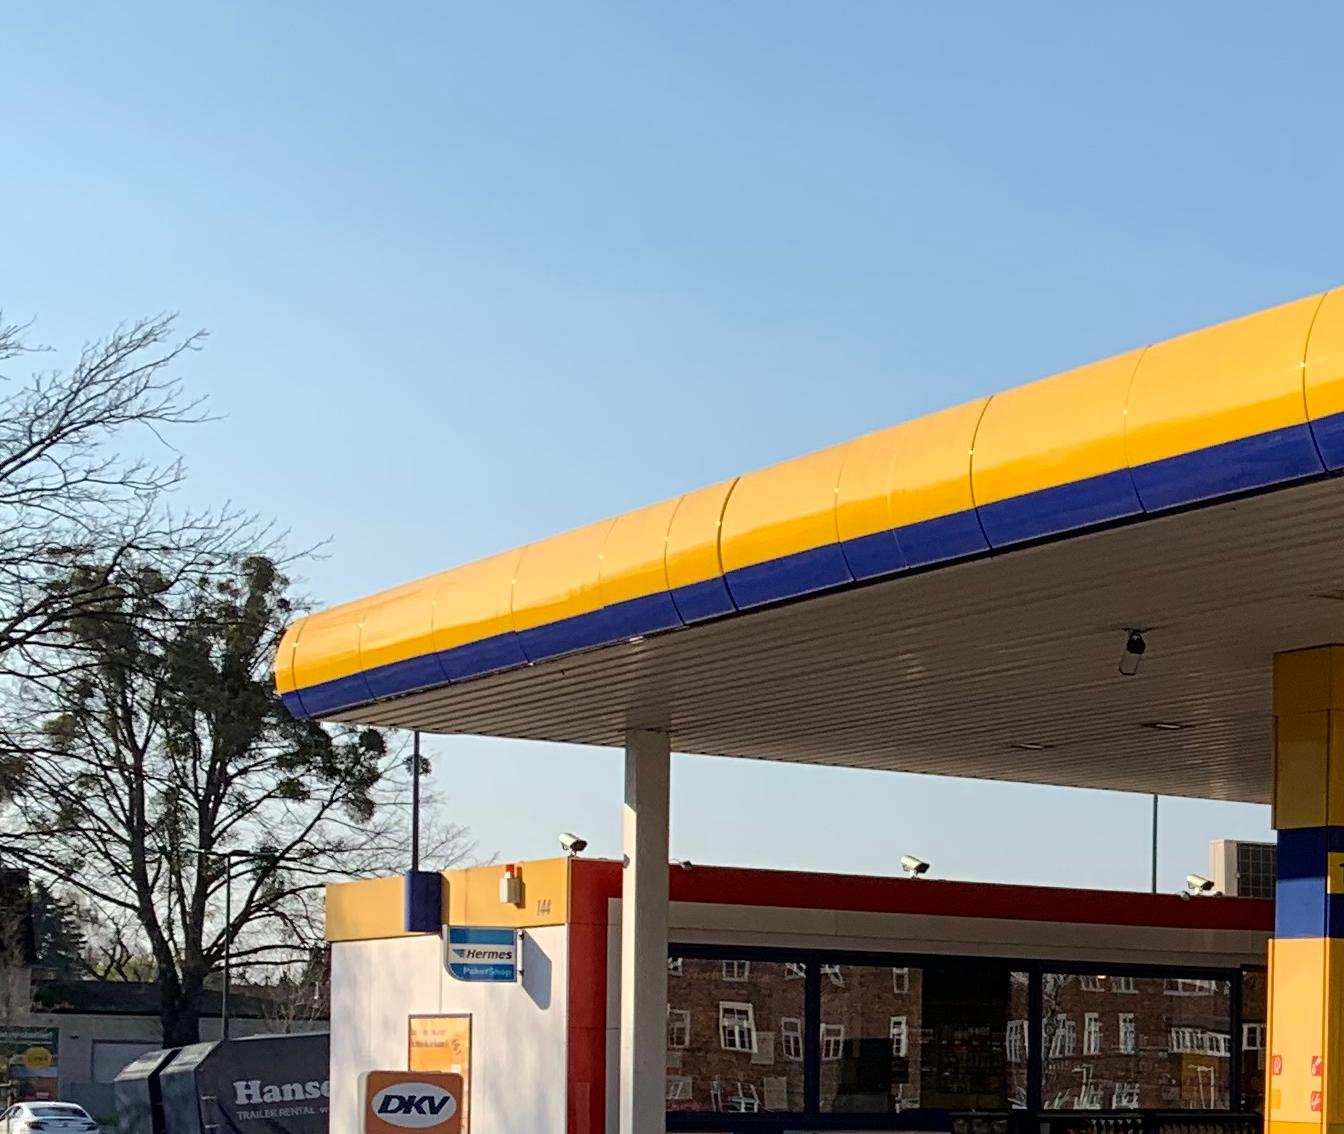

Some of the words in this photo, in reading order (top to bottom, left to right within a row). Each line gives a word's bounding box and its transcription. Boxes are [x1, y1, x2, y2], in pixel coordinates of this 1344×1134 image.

[537, 899, 552, 916] 144
[466, 949, 513, 960] Hermes
[378, 1095, 450, 1115] DKV
[237, 1108, 277, 1120] TRAILER
[279, 1106, 316, 1117] RENTAL
